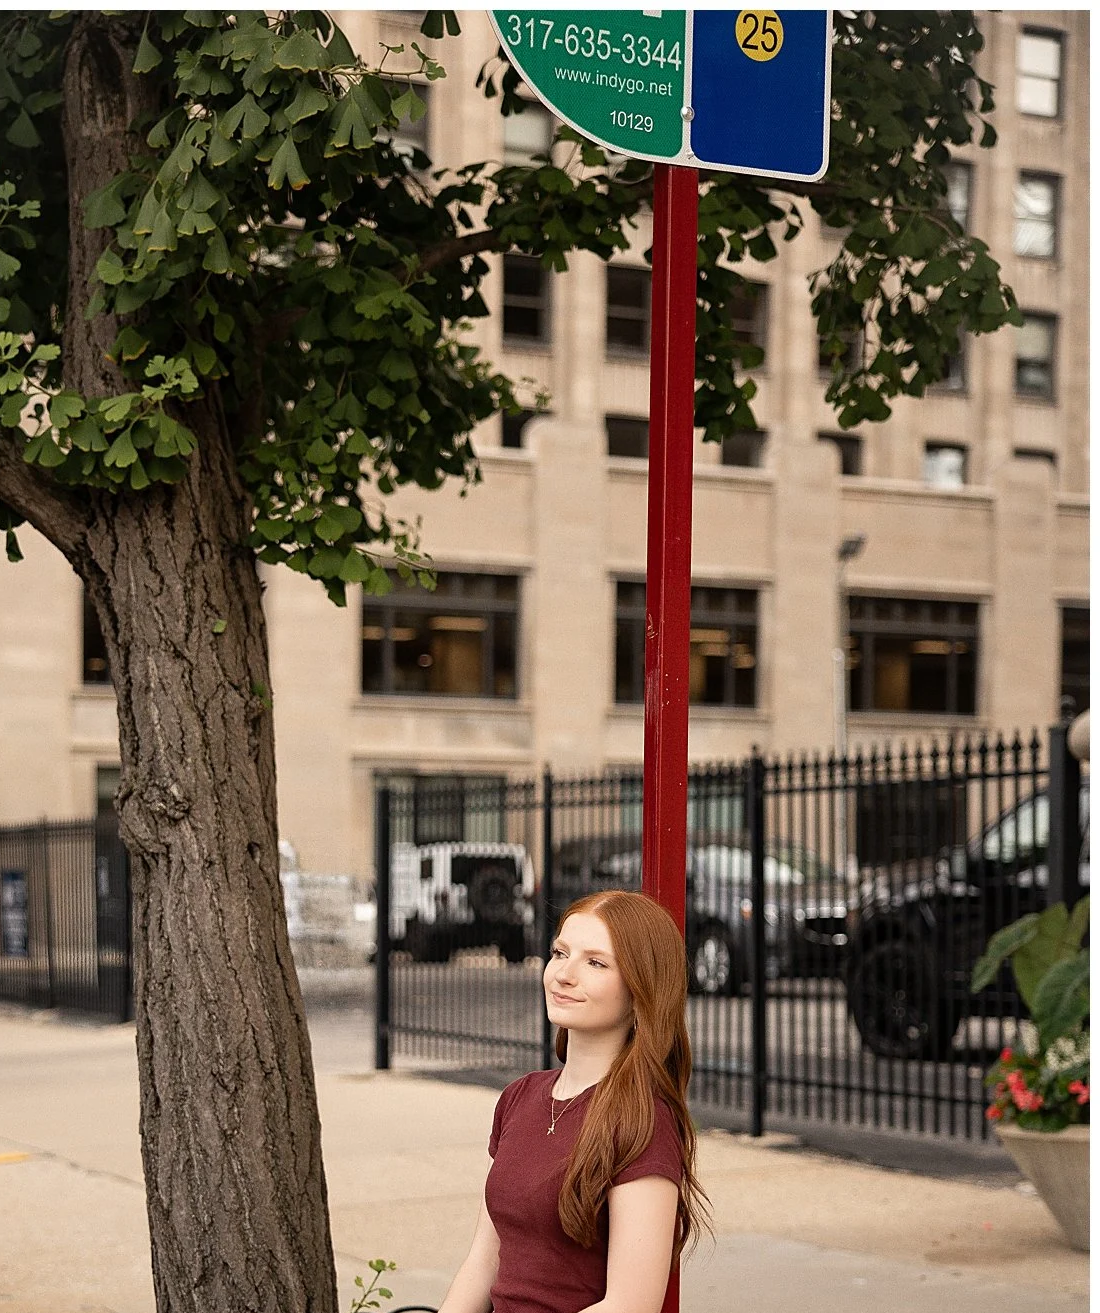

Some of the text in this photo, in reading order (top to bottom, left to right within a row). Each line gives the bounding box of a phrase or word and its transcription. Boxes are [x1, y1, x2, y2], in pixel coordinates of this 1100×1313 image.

[506, 15, 682, 71] 317-635-3344
[741, 13, 778, 53] 25
[554, 66, 673, 96] www.indygo.net
[609, 110, 654, 133] 10129
